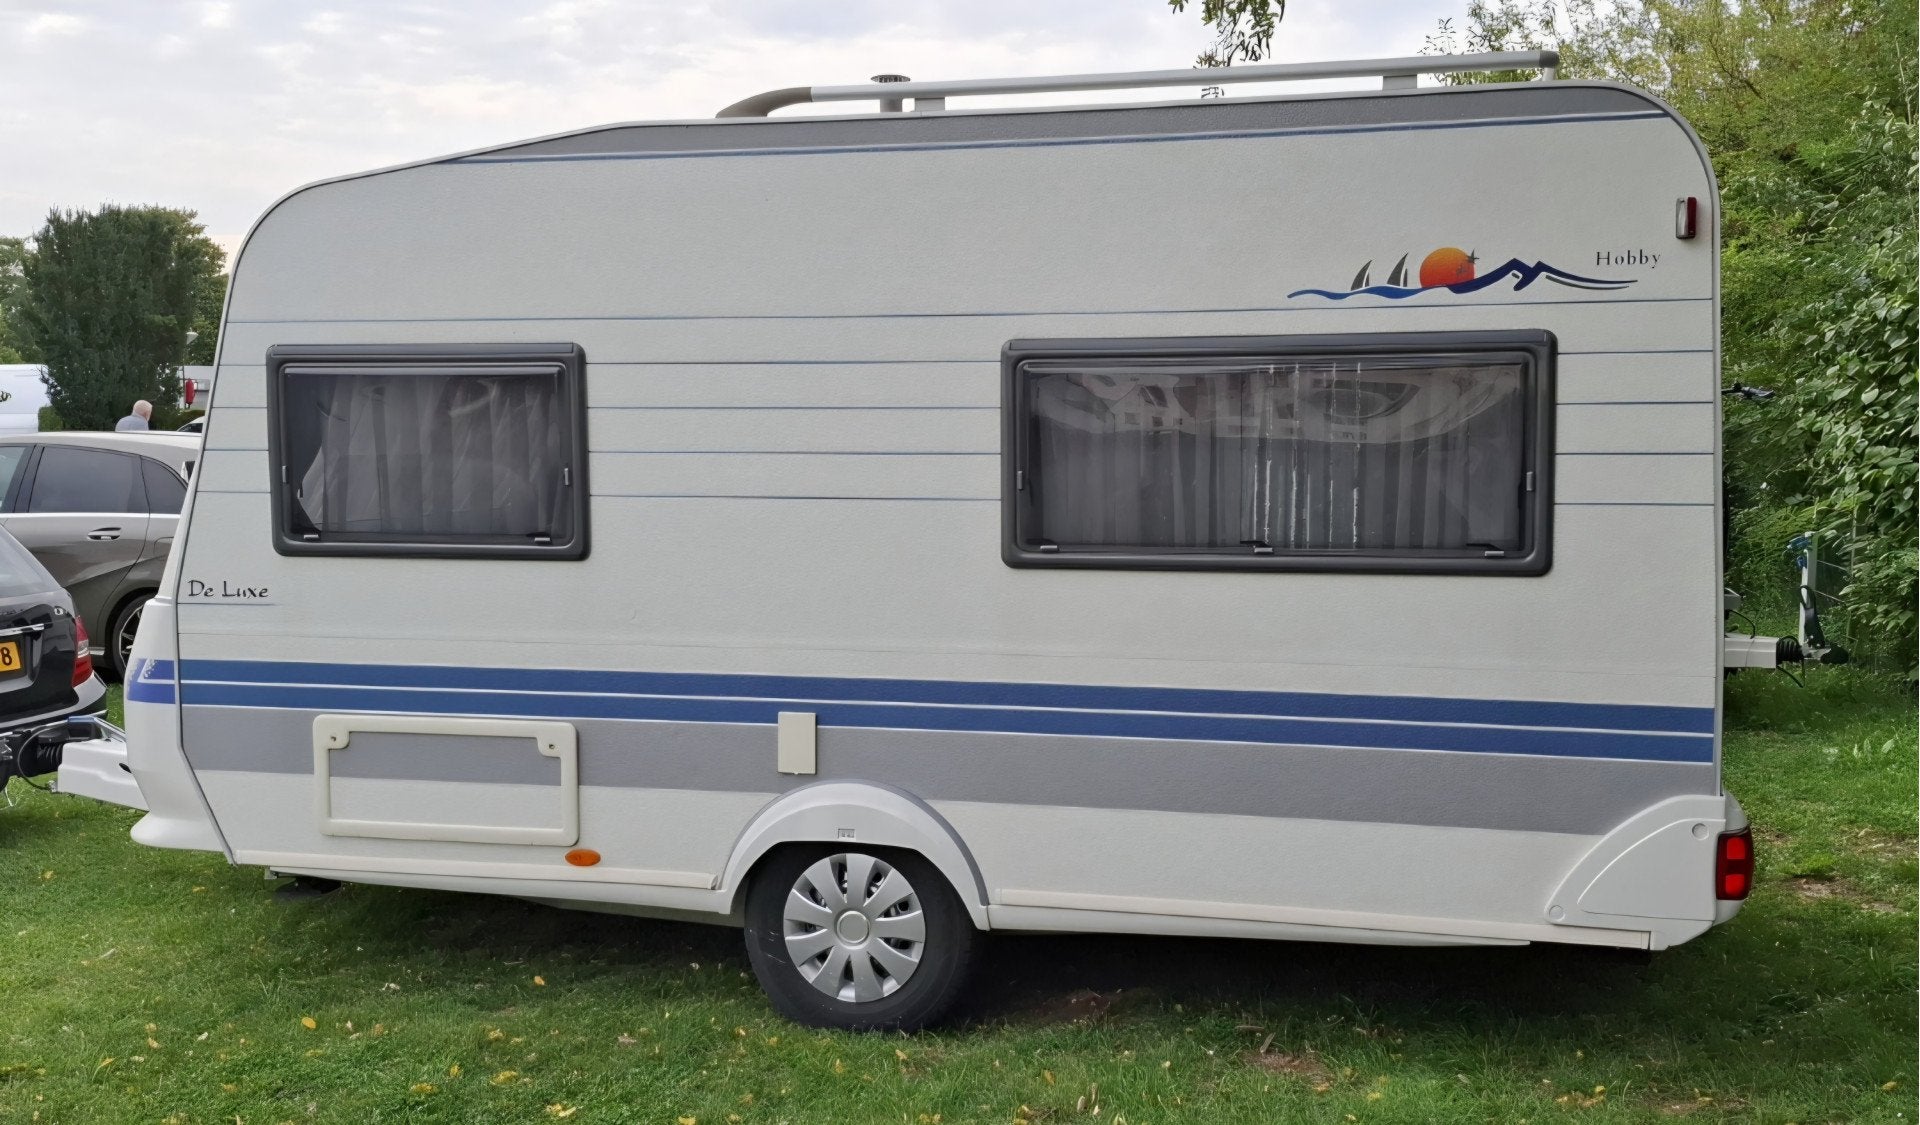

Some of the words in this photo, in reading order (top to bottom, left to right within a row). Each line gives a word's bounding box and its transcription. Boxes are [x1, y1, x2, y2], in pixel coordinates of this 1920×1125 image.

[1596, 249, 1661, 269] Hobby
[187, 579, 214, 597] De
[221, 580, 268, 598] Luxe
